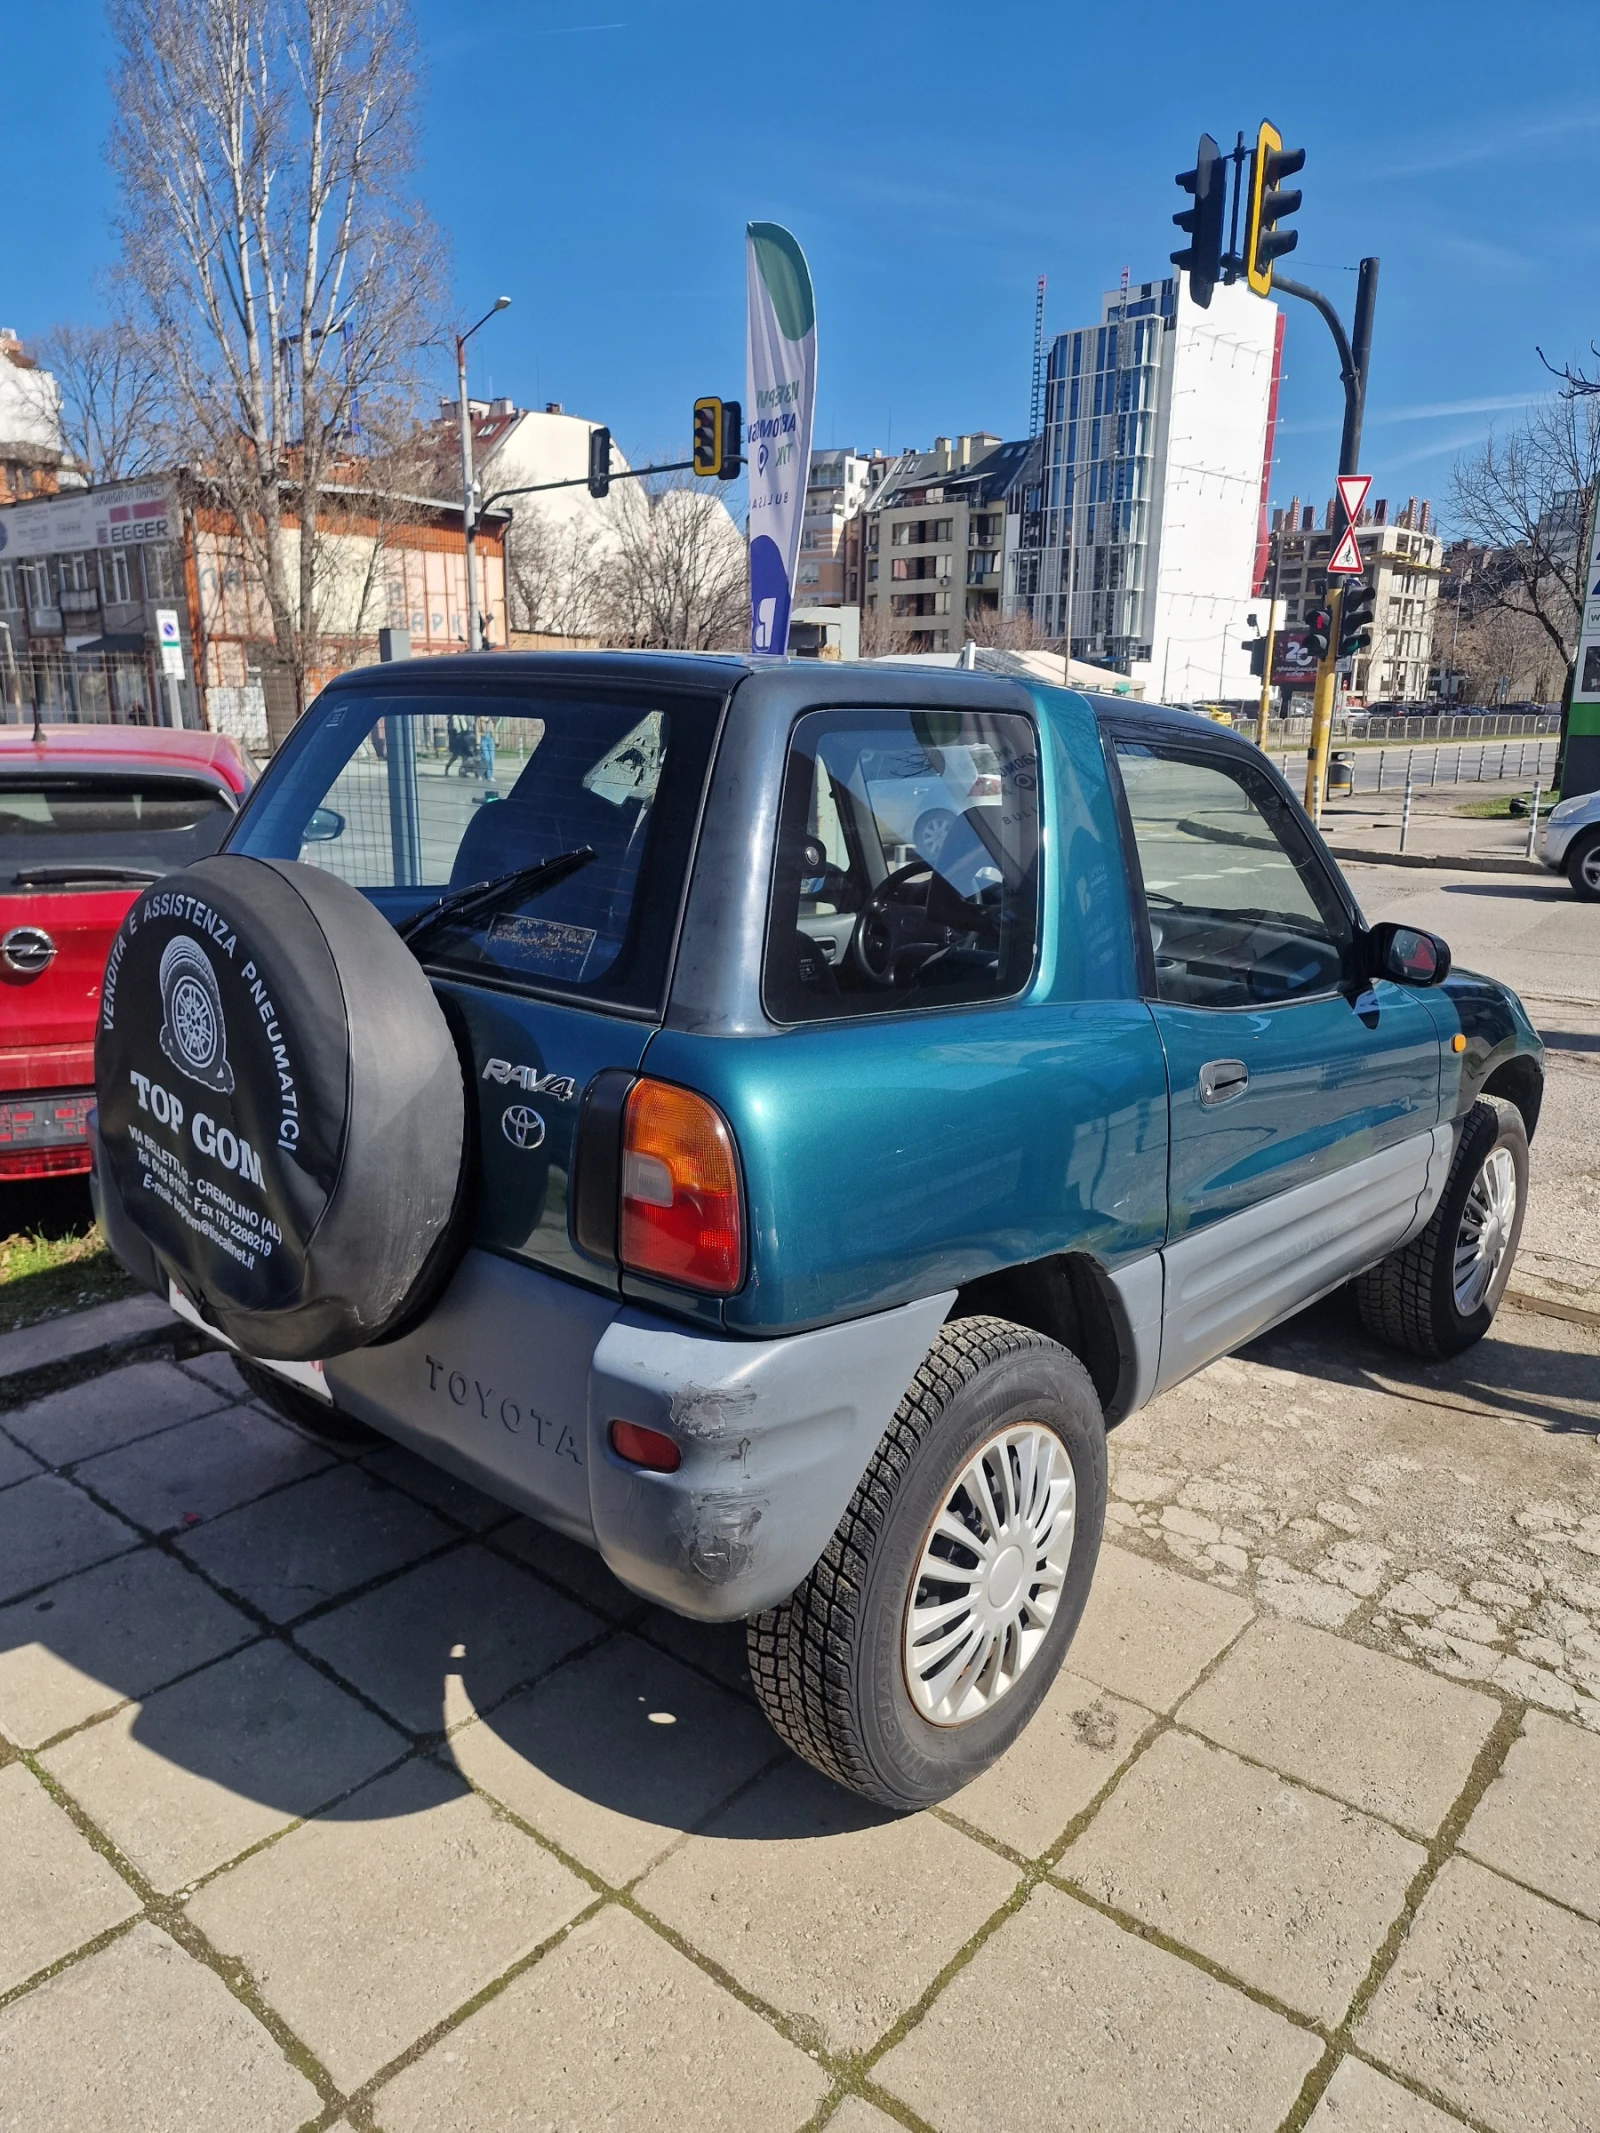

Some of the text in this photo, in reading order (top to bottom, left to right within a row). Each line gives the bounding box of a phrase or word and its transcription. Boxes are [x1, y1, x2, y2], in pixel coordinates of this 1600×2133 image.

[111, 519, 169, 543] EGGER
[103, 893, 300, 1151] VENDITA E ASSISTENZA PNEUMATICI
[130, 1070, 267, 1193] TOP GOM
[482, 1058, 575, 1101] RAV4
[128, 1124, 144, 1145] VIA
[196, 1178, 259, 1227] CREMOLINO
[261, 1217, 283, 1245] (AL)
[137, 1147, 151, 1168] Tel.
[194, 1197, 214, 1218] Fax
[215, 1209, 230, 1230] 178
[230, 1220, 272, 1256] 2286219
[426, 1354, 583, 1465] TOYOTA
